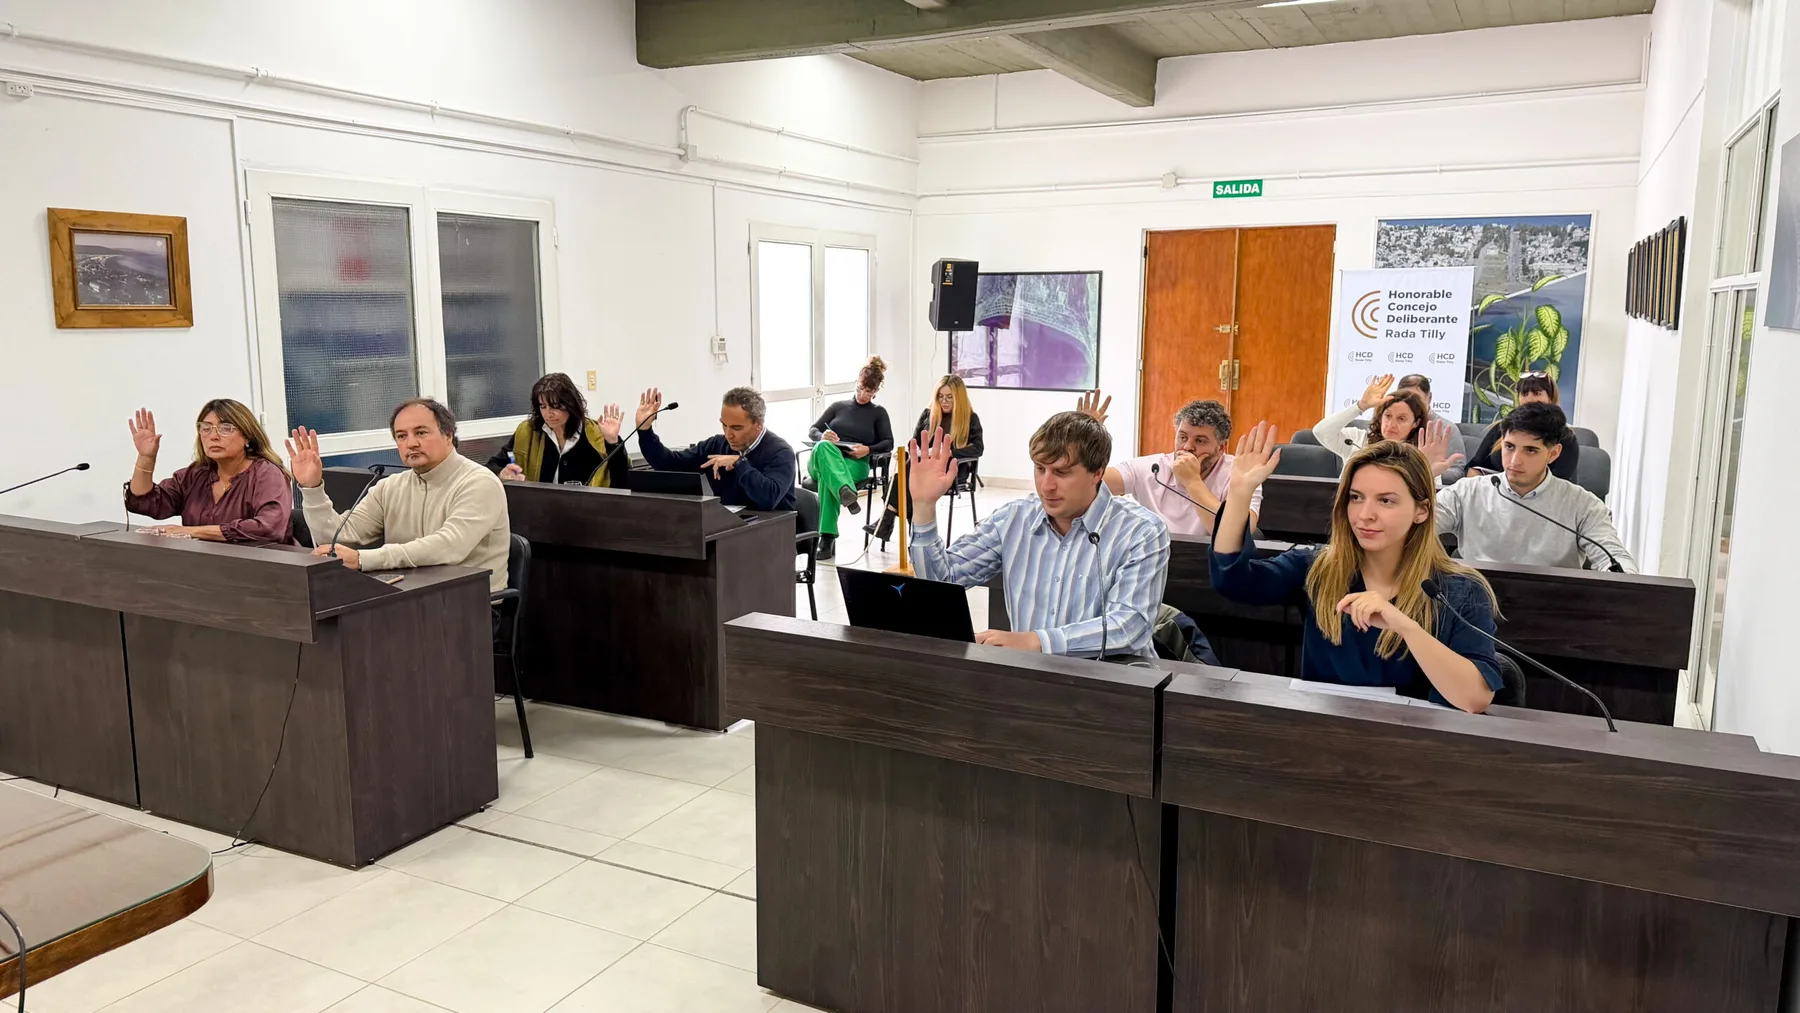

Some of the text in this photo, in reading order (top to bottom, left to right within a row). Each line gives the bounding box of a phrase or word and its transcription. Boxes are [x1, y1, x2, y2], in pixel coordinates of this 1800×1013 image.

[1215, 183, 1260, 195] SALIDA
[1388, 289, 1453, 299] Honorable
[1387, 302, 1437, 312] Concejo
[1386, 314, 1458, 324] Deliberante
[1385, 329, 1446, 340] Rada Tilly
